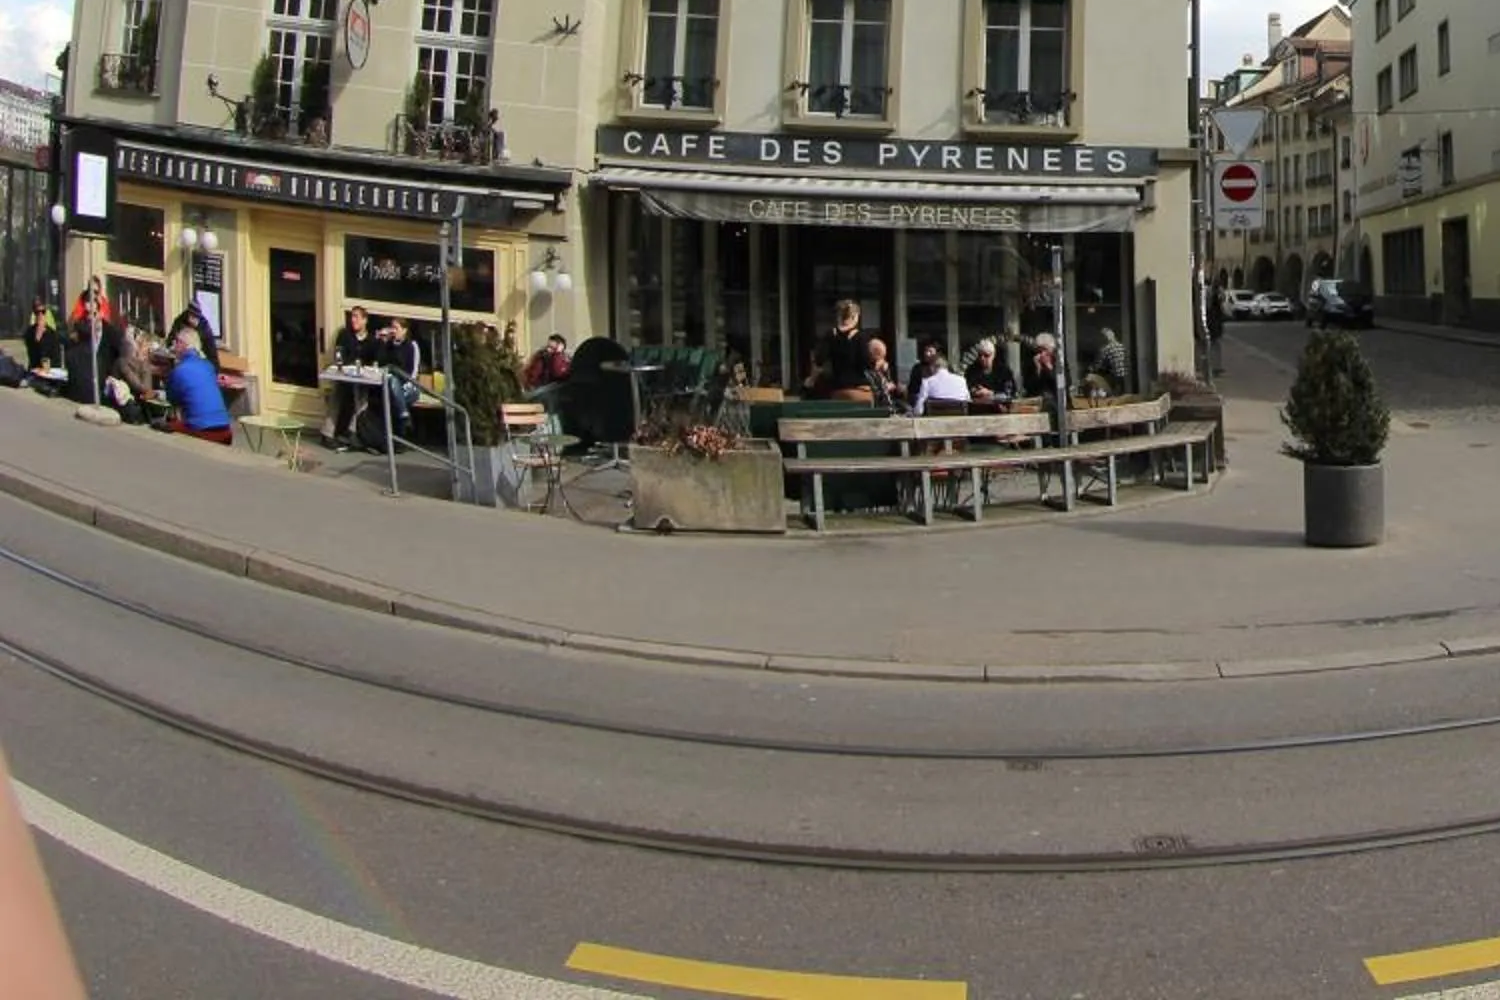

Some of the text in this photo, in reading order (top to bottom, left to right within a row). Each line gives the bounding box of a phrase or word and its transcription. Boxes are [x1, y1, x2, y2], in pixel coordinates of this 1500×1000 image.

[117, 150, 238, 188] RESTAURANT
[623, 131, 1127, 173] CAFE DES PYRENEES
[749, 199, 1018, 227] CAFE DES PYRENEES
